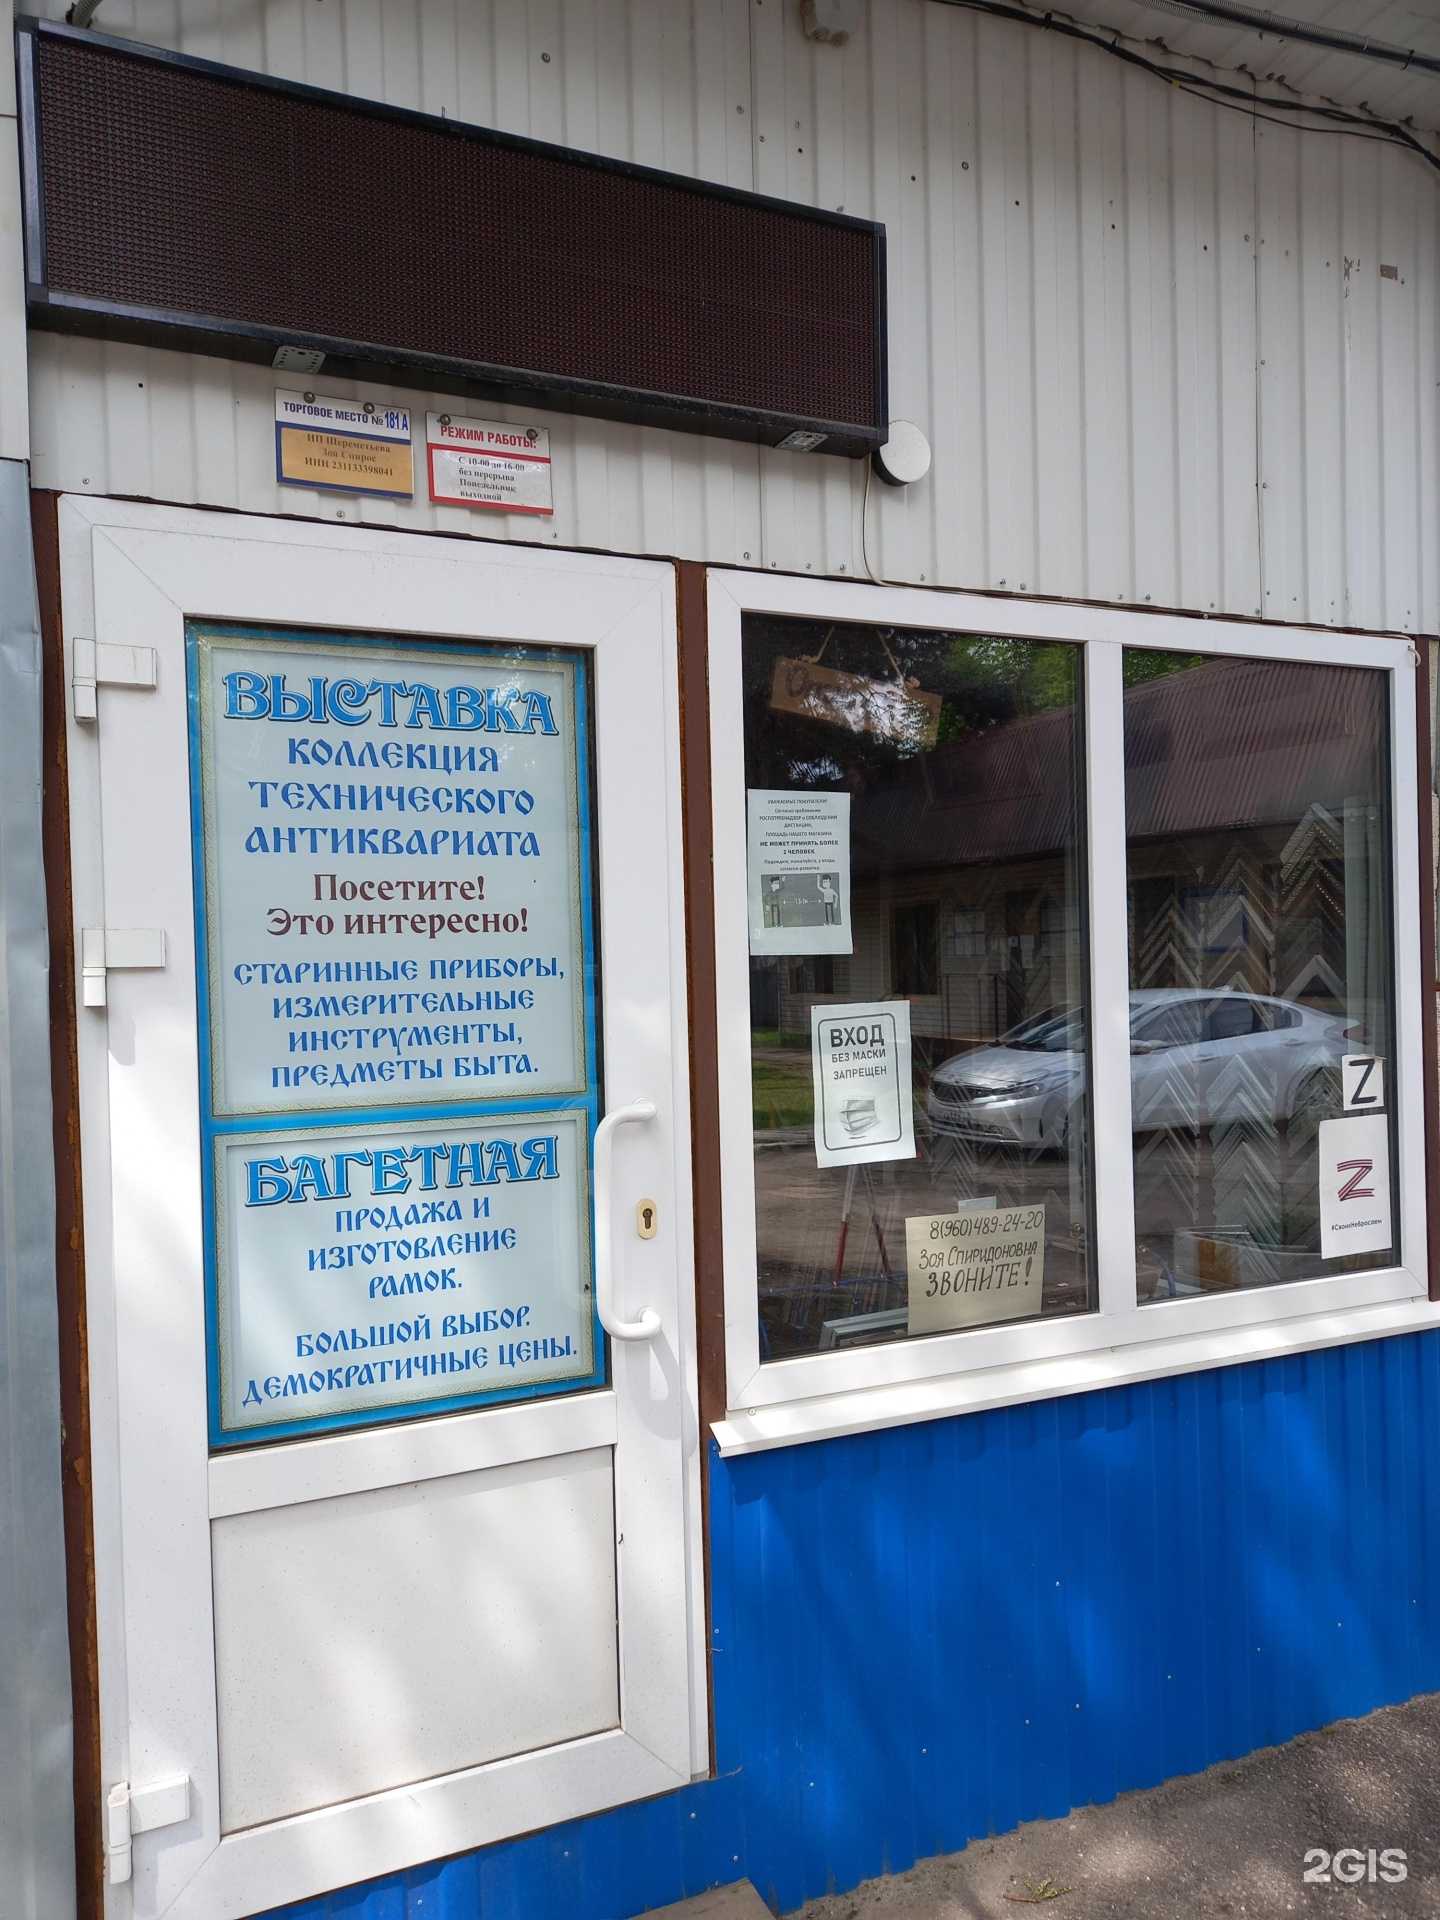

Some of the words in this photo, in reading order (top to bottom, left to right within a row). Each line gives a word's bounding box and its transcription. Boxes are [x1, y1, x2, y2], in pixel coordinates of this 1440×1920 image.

[283, 402, 333, 418] ТОРГОВОЕ
[335, 410, 369, 423] МЕСТО
[307, 433, 323, 443] ИП
[441, 425, 484, 442] РЕЖИМ
[488, 431, 537, 449] РАБОТЫ:
[305, 456, 329, 468] ИНН
[458, 456, 465, 464] С
[459, 467, 472, 476] без
[474, 470, 515, 482] перерыва
[222, 671, 560, 736] ВЫСТАВКА
[287, 738, 499, 775] КОЛЛЕКЦИЯ
[248, 780, 534, 815] ТЕХНИЧЕСКОГО
[244, 826, 541, 857] АНТИКВАРИАТА
[313, 874, 484, 901] Посетите!
[266, 908, 334, 936] Это
[344, 908, 528, 939] интересно!
[233, 959, 418, 986] СТАРИННЫЕ
[429, 956, 565, 980] ПРИБОРЫ,
[272, 989, 534, 1019] ИЗМЕРИТЕЛЬНЫЕ
[288, 1022, 523, 1055] ИНСТРУМЕНТЫ,
[830, 1024, 885, 1048] ВХОД
[271, 1057, 443, 1088] ПРЕДМЕТЫ
[454, 1053, 538, 1078] БЫТА.
[831, 1053, 850, 1063] БЕЗ
[853, 1049, 886, 1061] МАСКИ
[833, 1065, 887, 1080] ЗАПРЕЩЕН
[1349, 1058, 1378, 1105] Z
[244, 1134, 561, 1208] БАГЕТНАЯ
[1336, 1159, 1375, 1202] Z
[335, 1199, 462, 1233] ПРОДАЖА
[473, 1196, 490, 1218] И
[930, 1211, 1044, 1240] 8(960)489-24-20
[307, 1227, 517, 1271] ИЗГОТОВЛЕНИЕ
[918, 1248, 945, 1270] Зоя
[368, 1267, 463, 1299] РАМОК.
[926, 1256, 1033, 1298] ЗВОНИТЕ!
[296, 1314, 431, 1358] БОЛЬШОЙ
[442, 1305, 531, 1338] ВЫБОР.
[242, 1346, 489, 1408] ДЕМОКРАТИЧНЫЕ
[498, 1335, 578, 1368] ЦЕНЫ.
